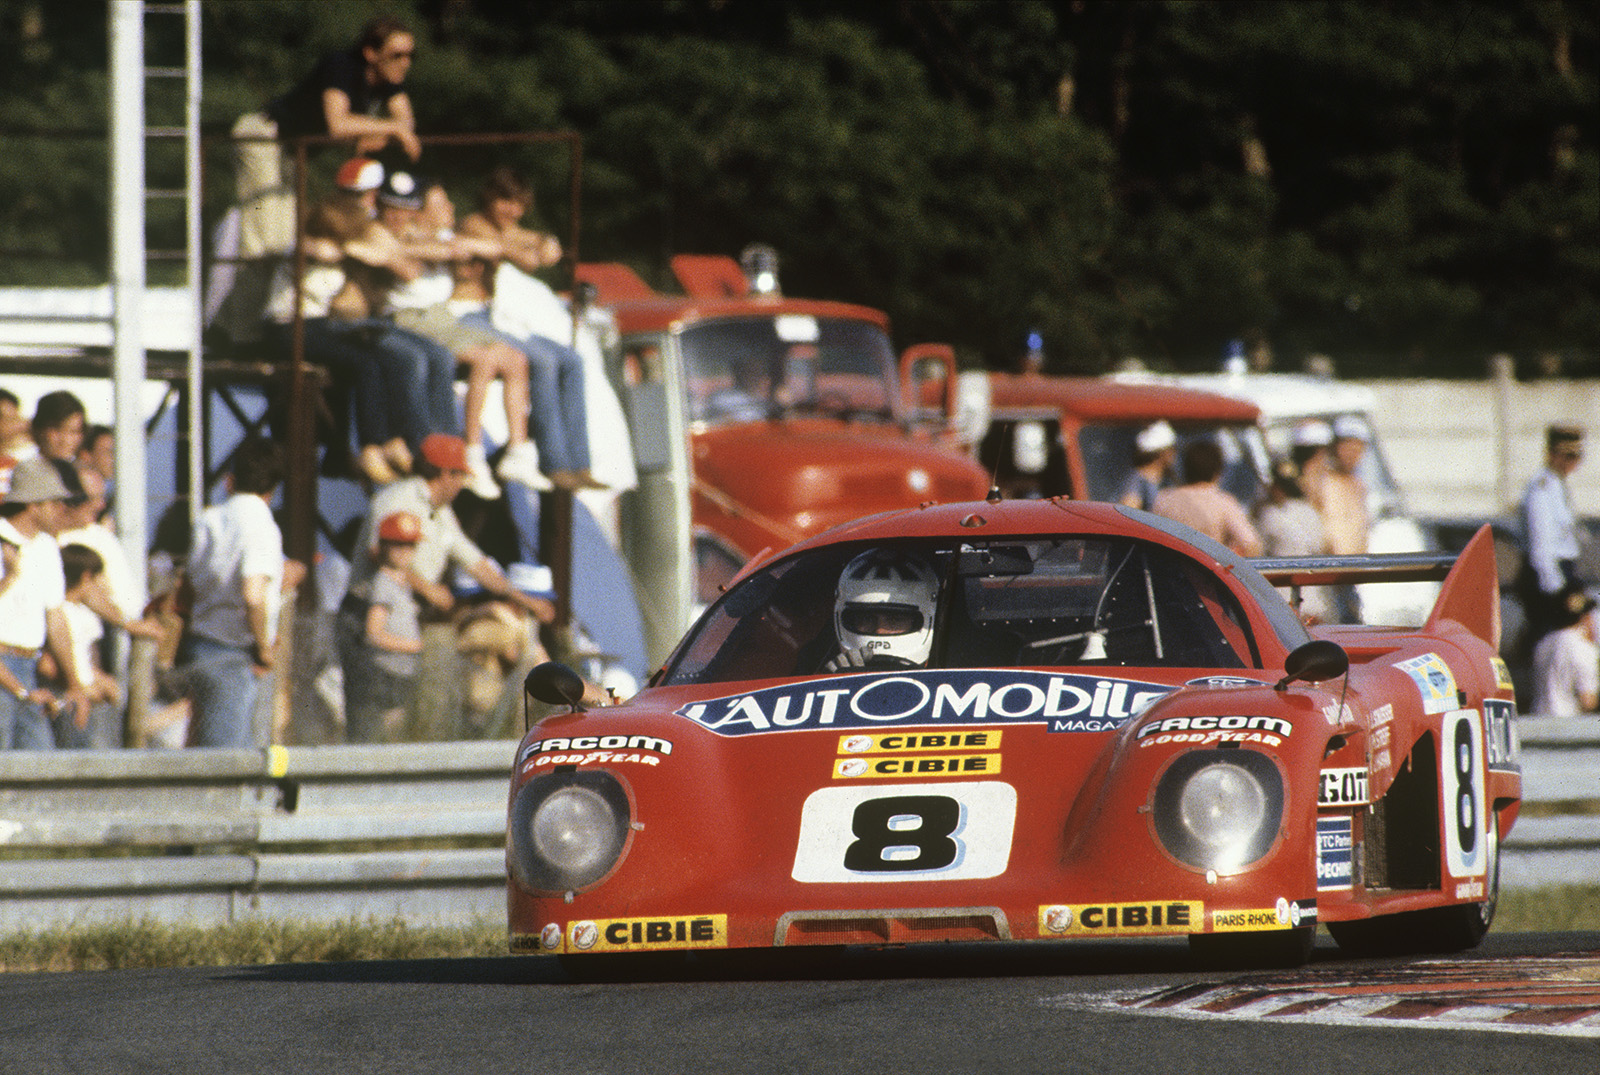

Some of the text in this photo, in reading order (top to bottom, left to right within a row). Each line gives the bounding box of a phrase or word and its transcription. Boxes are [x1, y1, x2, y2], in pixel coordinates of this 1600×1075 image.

[1137, 716, 1293, 739] FACOM
[1140, 730, 1282, 748] GOODYEAR
[521, 735, 673, 763] FACOM
[522, 751, 660, 774] GOODYEAR
[1455, 718, 1477, 853] 8
[844, 795, 966, 875] 8
[1216, 914, 1245, 926] PARIS
